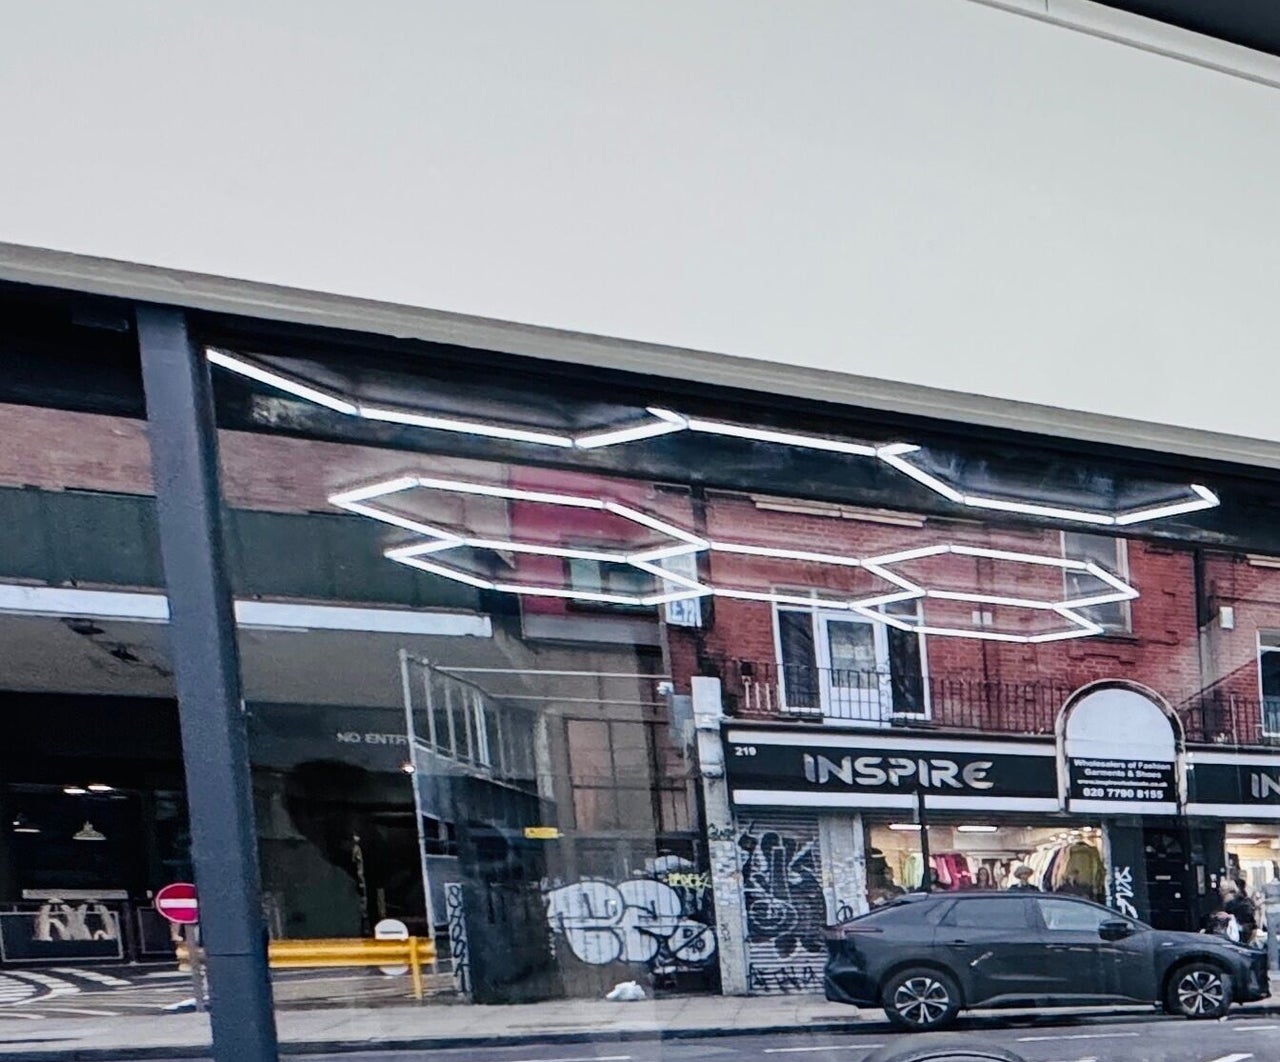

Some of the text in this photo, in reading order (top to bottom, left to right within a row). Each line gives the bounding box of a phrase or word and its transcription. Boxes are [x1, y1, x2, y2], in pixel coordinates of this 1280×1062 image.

[365, 733, 409, 745] ENTR
[735, 746, 757, 756] 219
[1127, 761, 1137, 769] of
[803, 753, 995, 790] INSPIRE
[1083, 787, 1104, 797] 020
[1106, 788, 1135, 798] 7790
